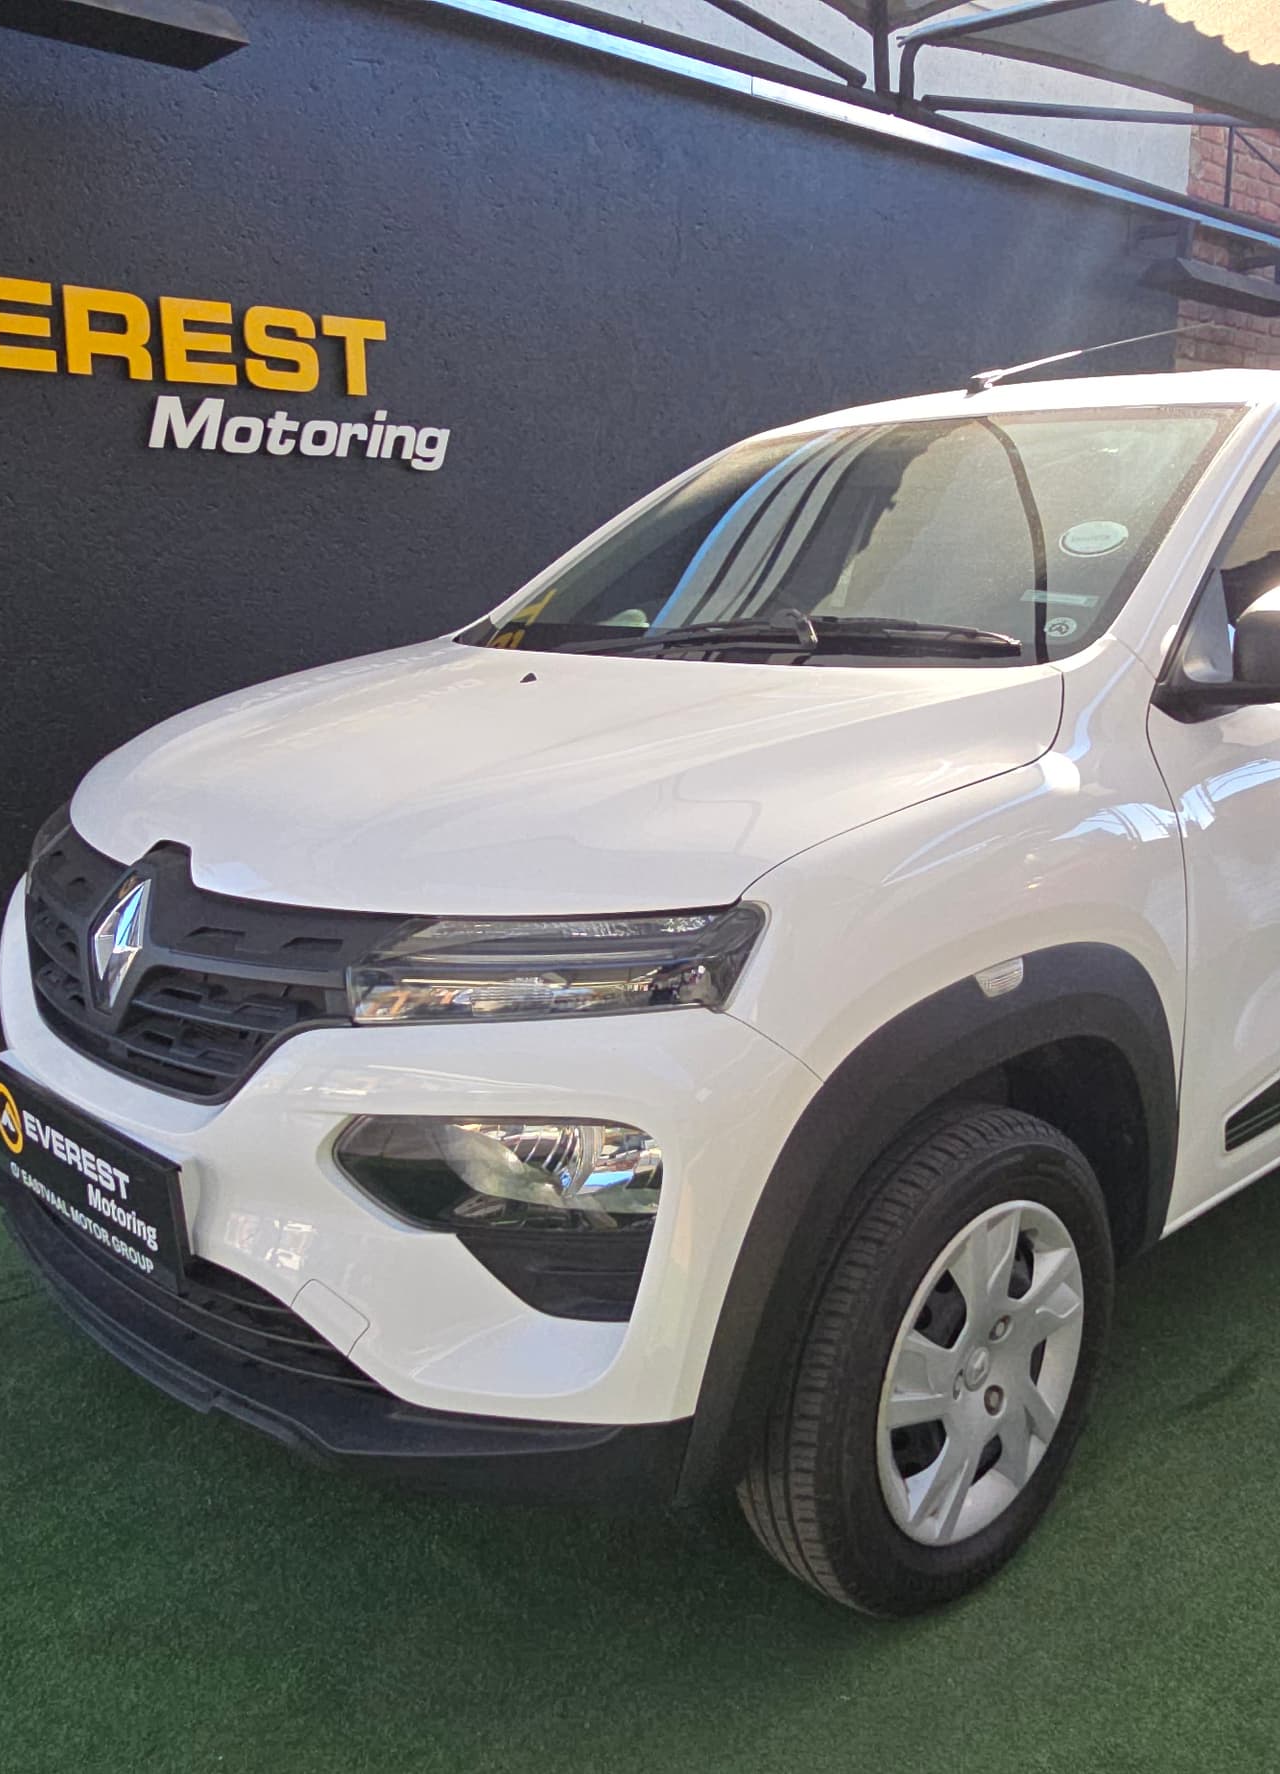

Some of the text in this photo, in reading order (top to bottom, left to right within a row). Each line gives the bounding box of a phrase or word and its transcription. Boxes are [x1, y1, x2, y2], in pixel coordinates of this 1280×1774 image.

[148, 395, 450, 471] Motoring
[22, 1109, 130, 1200] EVEREST
[21, 1169, 155, 1275] EASTVAAL MOTOR GROUP
[86, 1183, 159, 1253] Motoring
